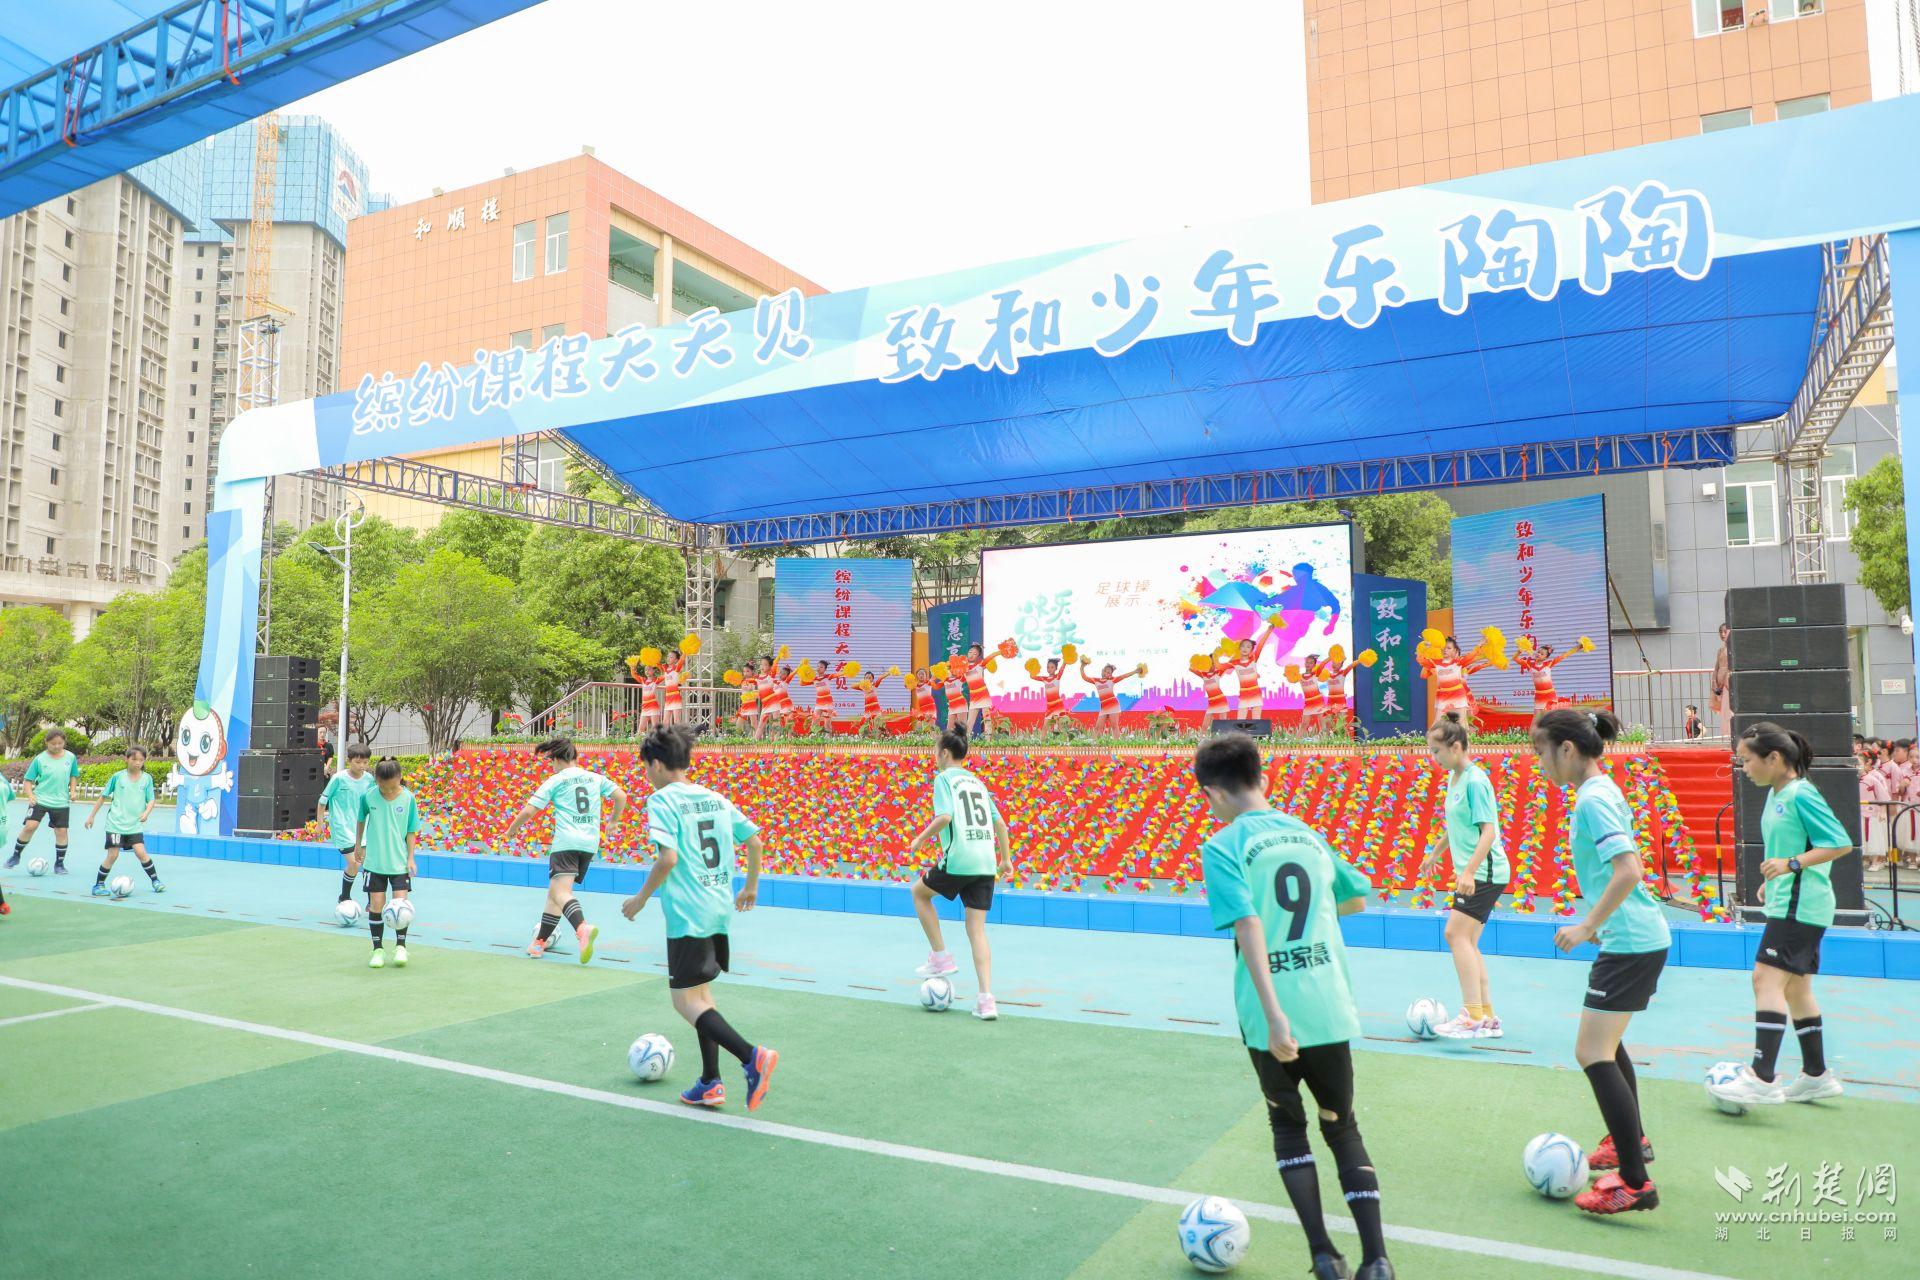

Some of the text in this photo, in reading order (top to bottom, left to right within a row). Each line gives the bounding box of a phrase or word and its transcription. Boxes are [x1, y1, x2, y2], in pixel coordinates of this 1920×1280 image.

[352, 180, 1717, 435] 缤纷课程天天见 致和少年乐陶陶
[1375, 597, 1404, 715] 致和未来
[575, 786, 590, 814] 6
[959, 790, 988, 826] 15
[697, 819, 721, 869] 5
[1274, 862, 1311, 941] 9
